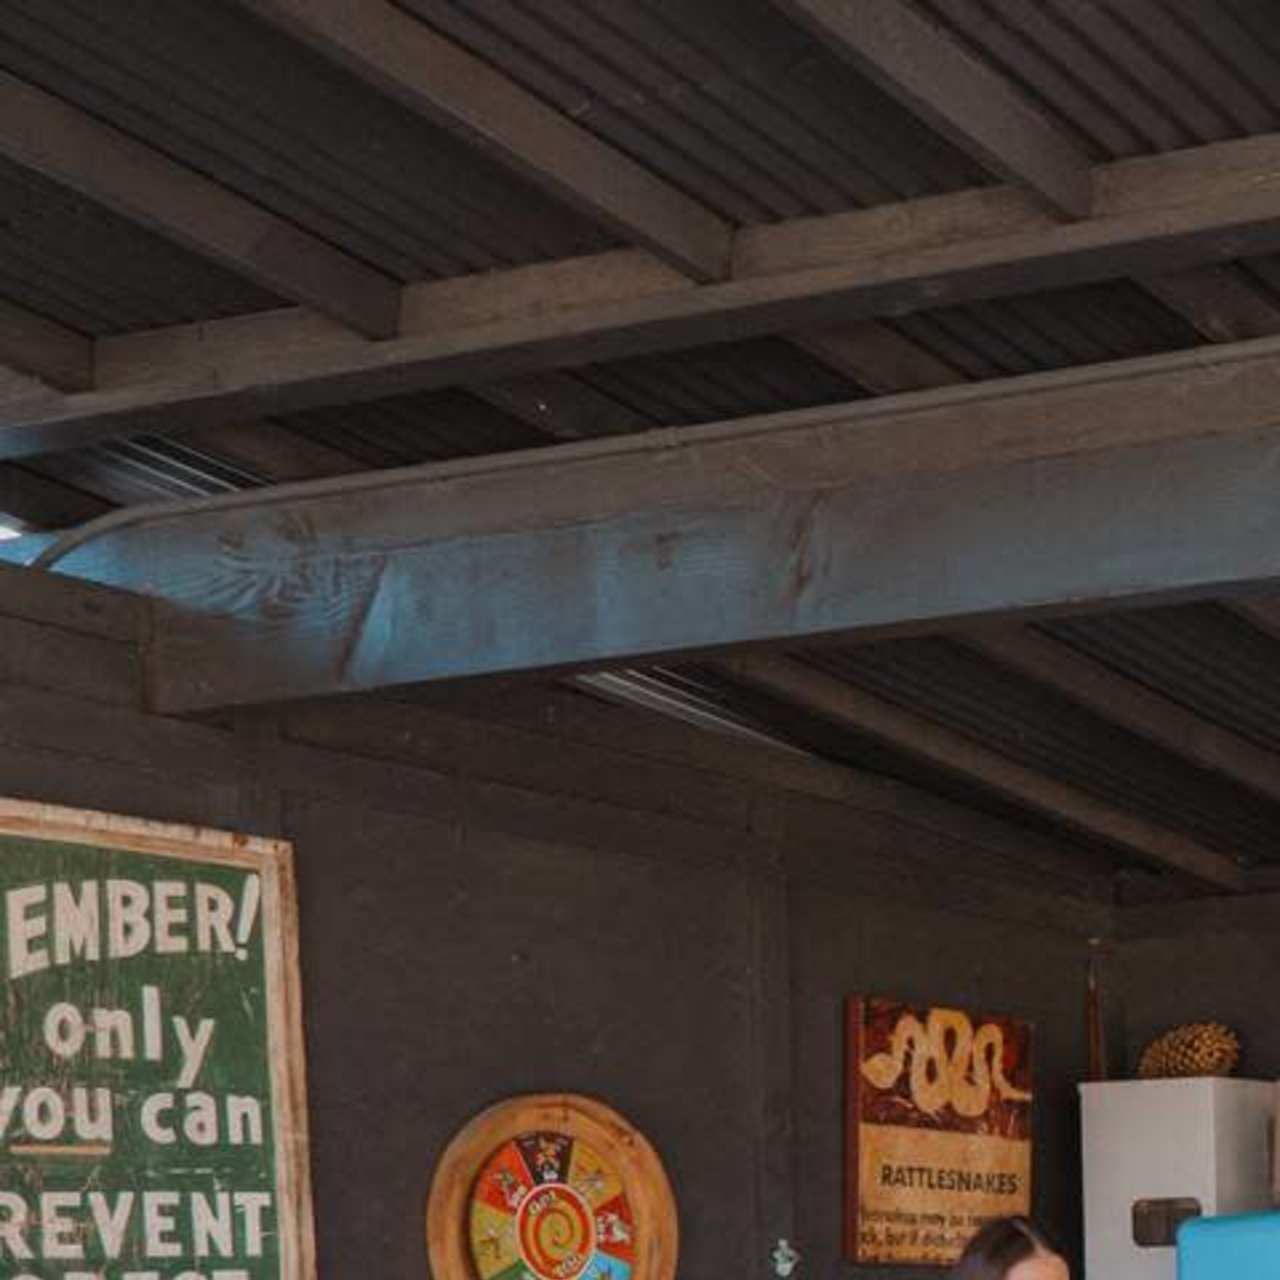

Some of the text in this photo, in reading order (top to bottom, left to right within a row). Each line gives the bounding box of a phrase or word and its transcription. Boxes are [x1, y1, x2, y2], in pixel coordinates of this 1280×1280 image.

[5, 873, 260, 980] EMBER!
[43, 985, 214, 1089] only
[140, 1091, 262, 1145] can
[880, 1164, 1019, 1195] RATTLESNAKES
[0, 1191, 271, 1259] REVENT
